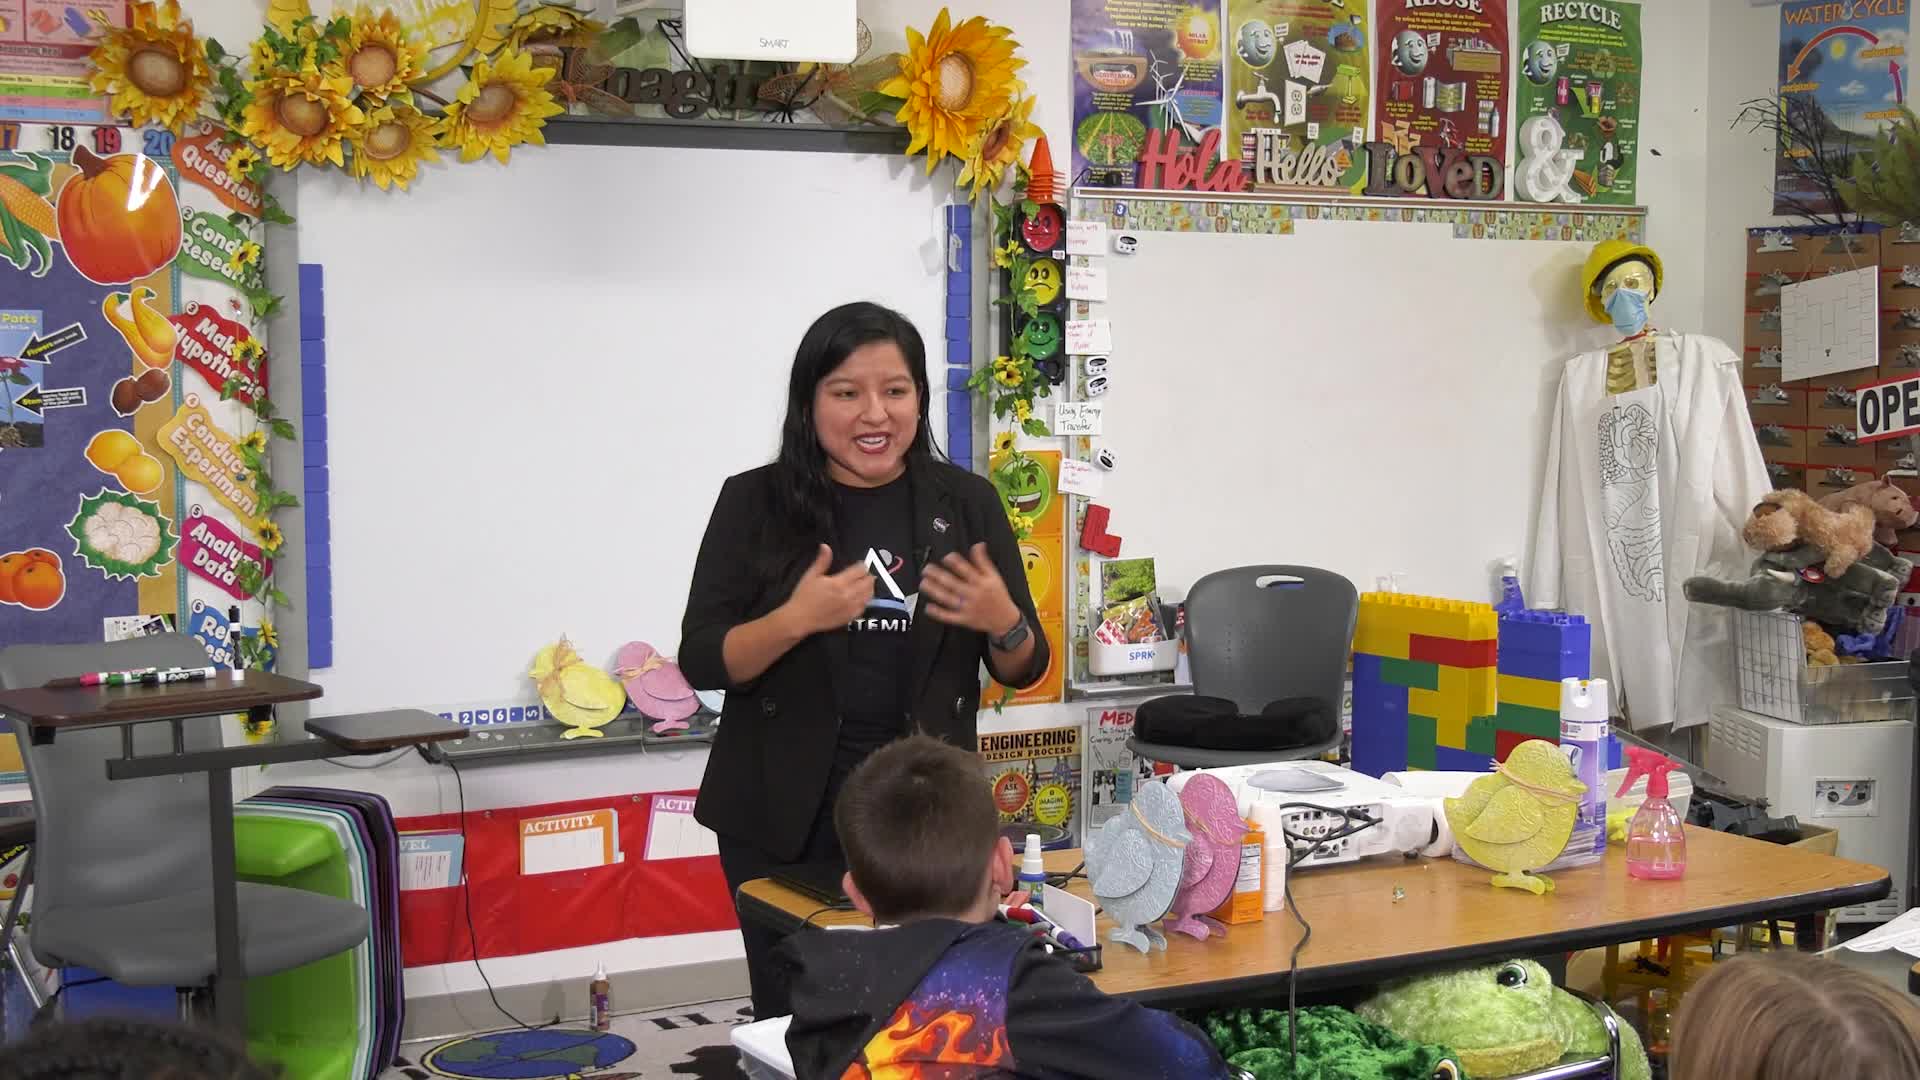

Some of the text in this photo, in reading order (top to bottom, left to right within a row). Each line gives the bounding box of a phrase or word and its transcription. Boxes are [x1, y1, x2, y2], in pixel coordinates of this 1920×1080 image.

[1540, 2, 1622, 30] RECYCLE
[1784, 0, 1905, 25] WATER CYCLE
[759, 38, 790, 49] SMART
[48, 126, 75, 151] 18
[93, 126, 121, 154] 19
[144, 129, 176, 156] 20
[205, 137, 232, 163] As
[1140, 128, 1249, 192] Hola
[1254, 129, 1345, 186] Hello
[195, 317, 236, 356] Mak
[1860, 381, 1920, 435] OPE
[192, 547, 237, 585] Data
[849, 619, 911, 632] TEMI
[1100, 710, 1133, 726] MED
[981, 729, 1076, 752] ENGINEERING
[986, 747, 1073, 761] DESIGN PROCESS
[1004, 783, 1018, 792] ASK
[524, 815, 595, 835] ACTIVITY
